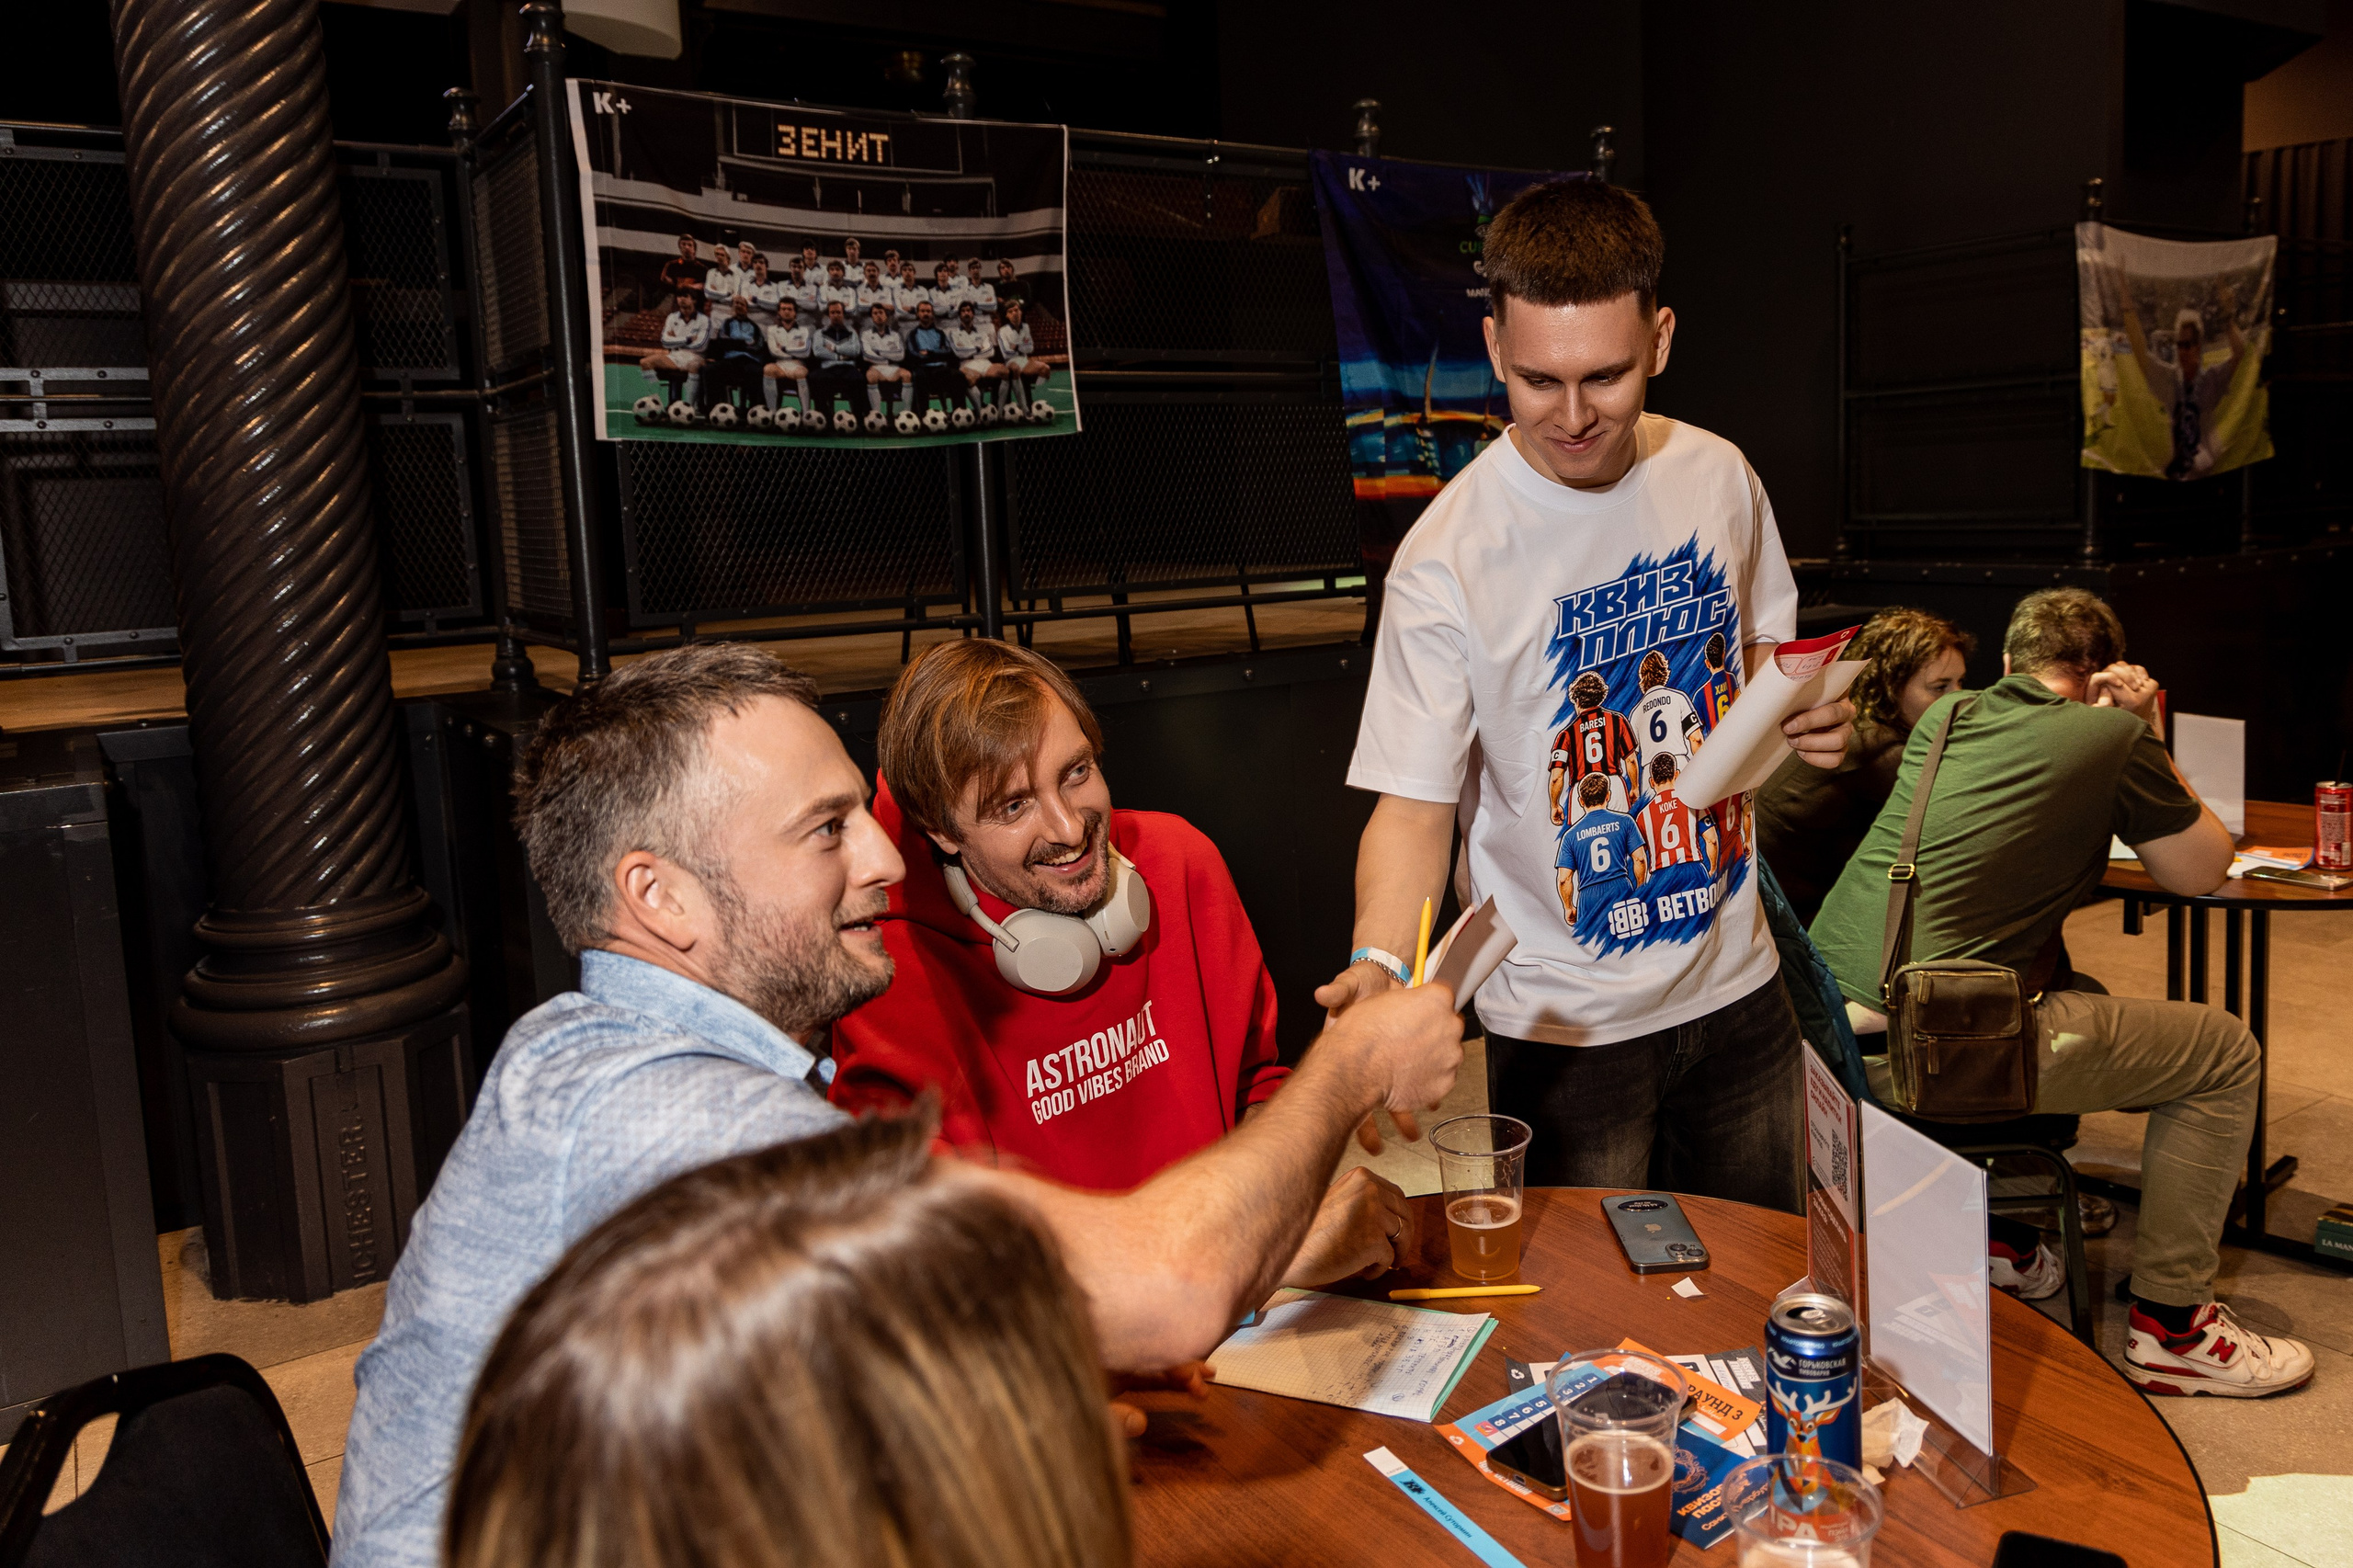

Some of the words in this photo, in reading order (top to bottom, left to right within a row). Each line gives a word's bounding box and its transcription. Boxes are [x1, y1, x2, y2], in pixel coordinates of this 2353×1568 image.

[778, 123, 889, 164] ЗЕНИТ
[1553, 559, 1694, 640] КВИЗ
[1577, 585, 1731, 671] ПЛЮС
[1643, 695, 1672, 714] REDONDO
[1579, 716, 1607, 733] BARESI
[1649, 709, 1668, 743] 6
[1584, 731, 1604, 765] 6
[1658, 799, 1678, 814] KOKE
[1576, 821, 1620, 842] LOMBAERTS
[1661, 812, 1681, 850] 6
[1590, 836, 1611, 873] 6
[1027, 999, 1157, 1099] ASTRONAUT
[1031, 1088, 1075, 1126] GOOD
[1076, 1067, 1123, 1106] VIBES
[1125, 1038, 1170, 1085] BRAND
[1799, 1357, 1847, 1369] ГОРЬКОВСКАЯ
[2207, 1335, 2237, 1364] N
[1507, 1410, 1519, 1420] 7
[1521, 1406, 1533, 1415] 6
[1534, 1400, 1547, 1408] 5
[1732, 1409, 1744, 1421] 3
[1495, 1417, 1506, 1426] 8
[1422, 1496, 1448, 1517] Алексей
[1445, 1514, 1473, 1539] Сутормин
